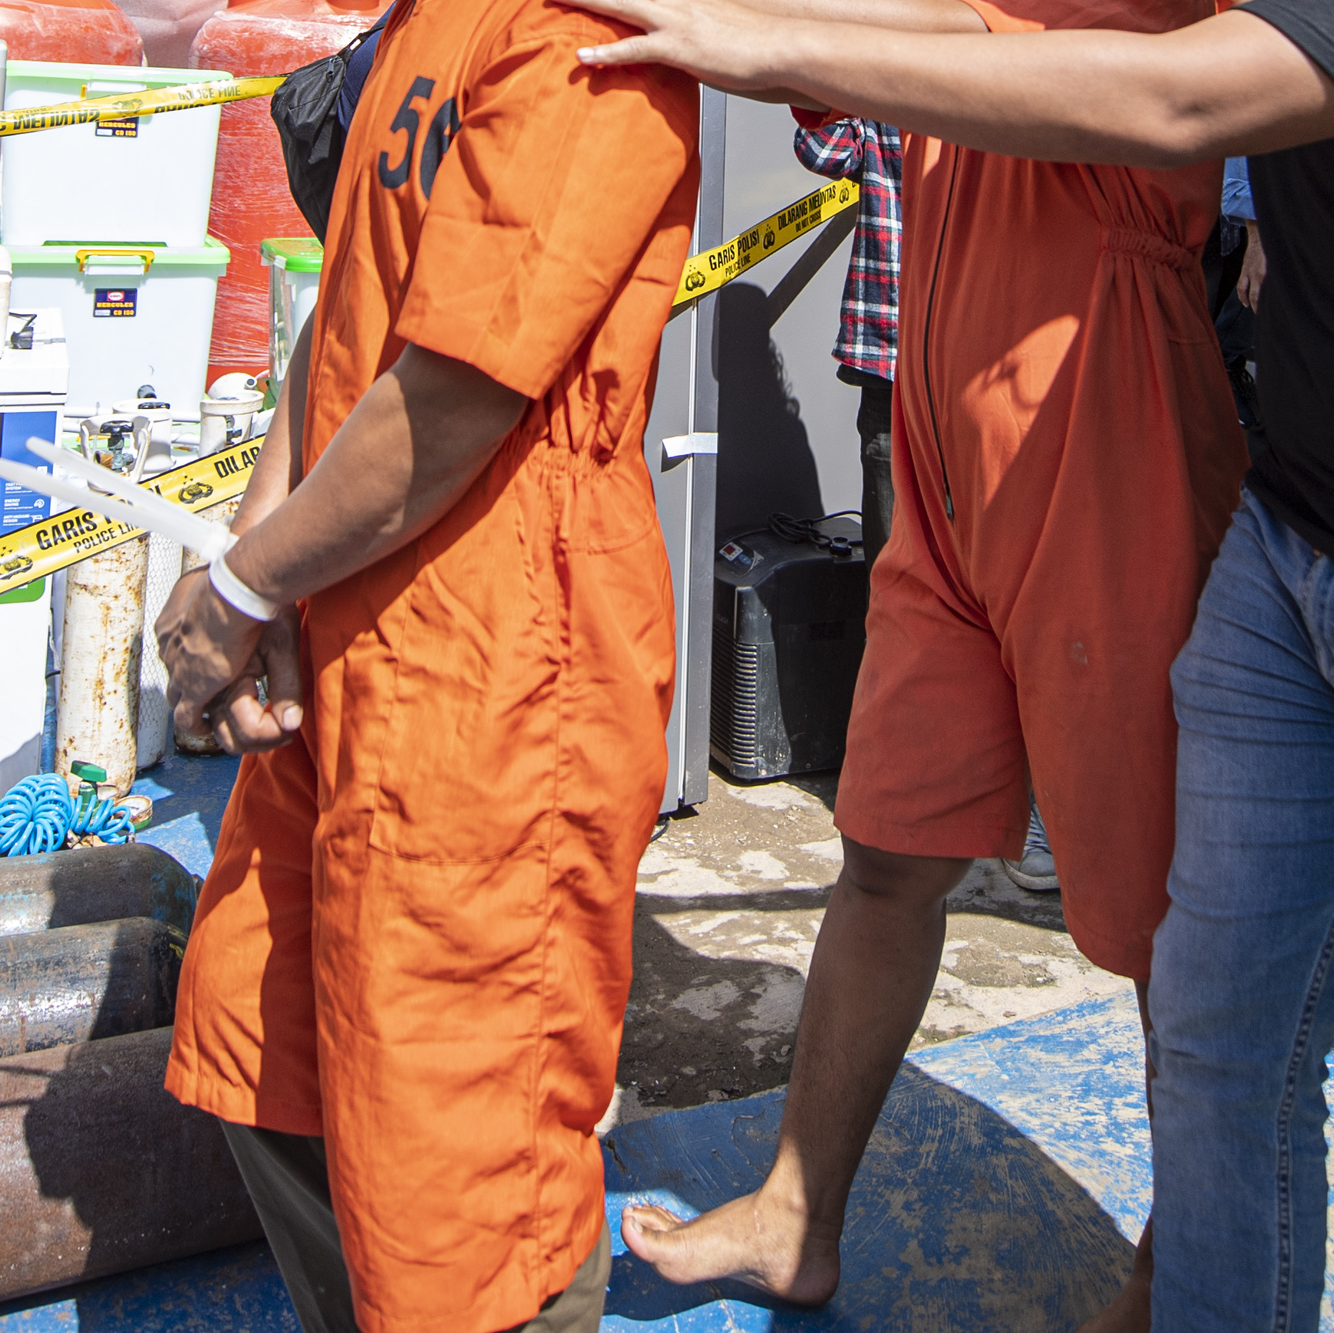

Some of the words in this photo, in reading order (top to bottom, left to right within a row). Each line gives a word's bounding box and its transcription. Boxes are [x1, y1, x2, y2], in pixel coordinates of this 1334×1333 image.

[777, 204, 808, 231] DILARANG
[709, 244, 736, 271] GARIS
[737, 229, 760, 256] POLISI
[214, 446, 260, 479] DILAR
[36, 511, 97, 551] GARIS
[74, 528, 117, 554] POLICE
